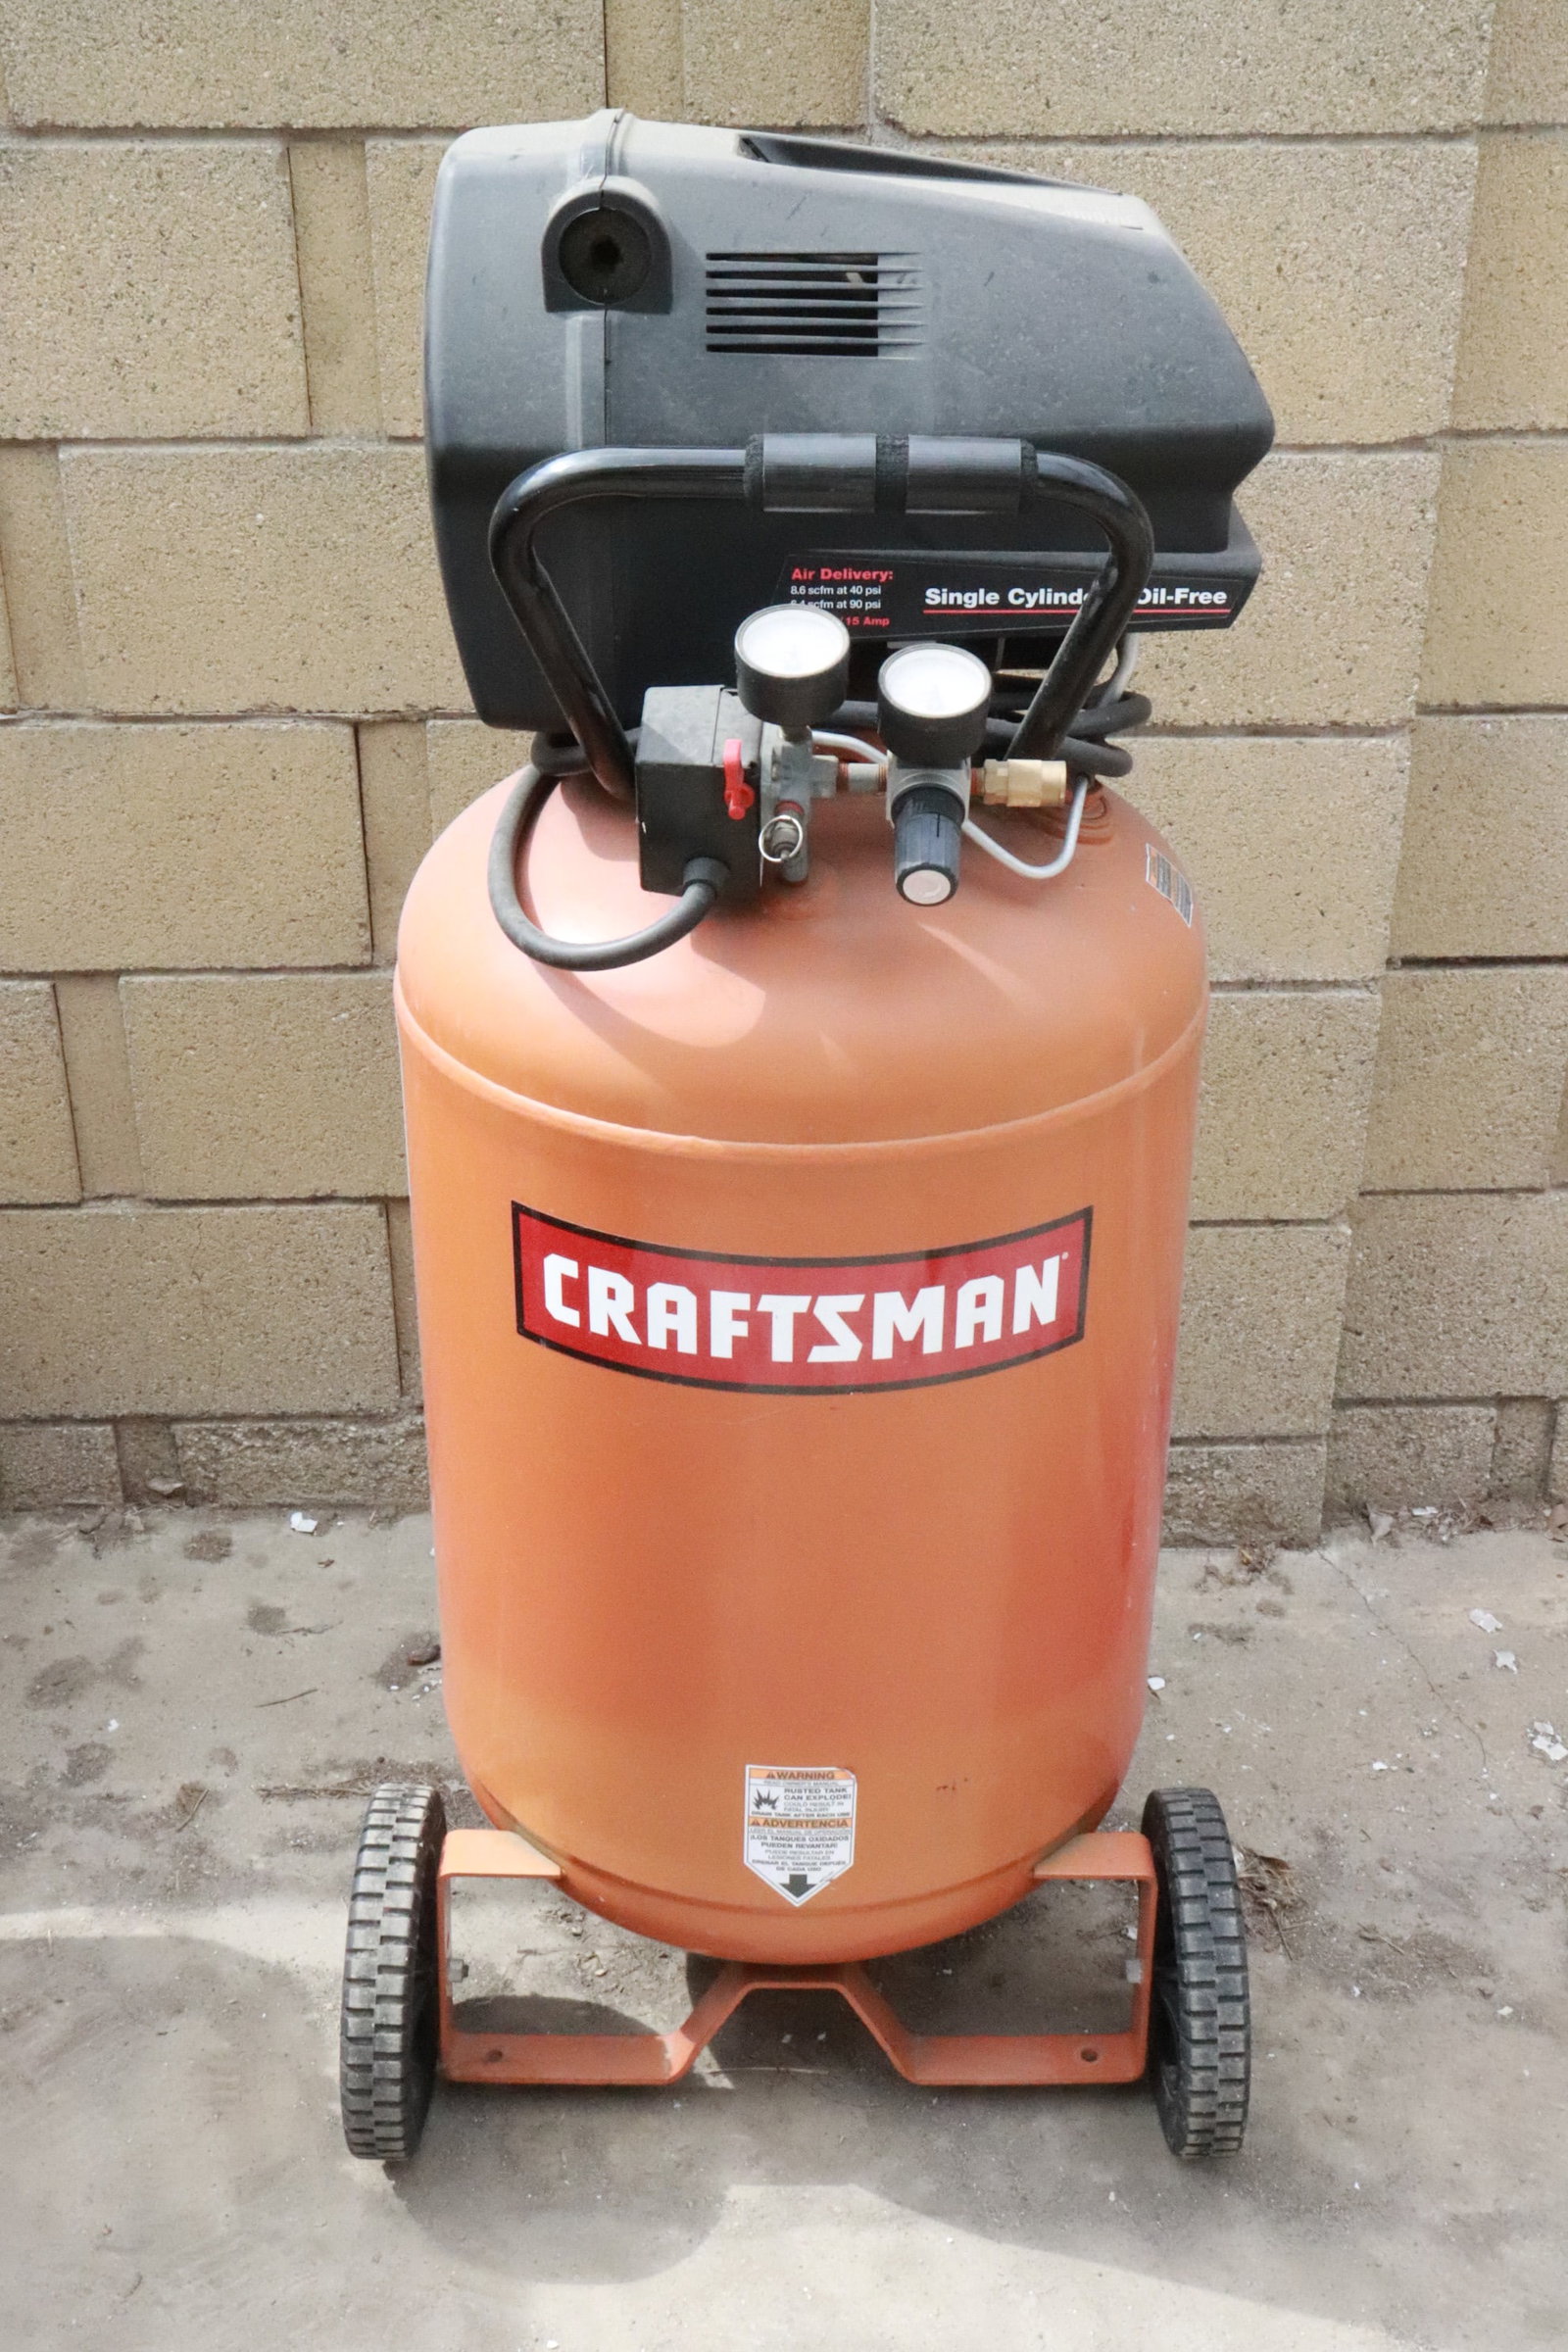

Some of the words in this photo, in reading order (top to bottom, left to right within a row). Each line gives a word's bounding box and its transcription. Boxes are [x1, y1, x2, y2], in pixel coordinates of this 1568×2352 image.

[792, 568, 815, 580] Air
[820, 568, 894, 582] Delivery:
[790, 585, 806, 595] 8.6
[808, 585, 834, 595] scfm
[837, 586, 848, 595] at
[850, 585, 863, 595] 40
[865, 585, 882, 598] psi
[925, 587, 1000, 609] Single
[1137, 587, 1228, 605] Oil-Free
[837, 600, 848, 609] at
[850, 599, 863, 609] 90
[865, 599, 882, 611] psi
[863, 616, 890, 627] Amp
[542, 1252, 1060, 1363] CRAFTSMAN
[762, 1819, 848, 1828] ADVERTENCIA
